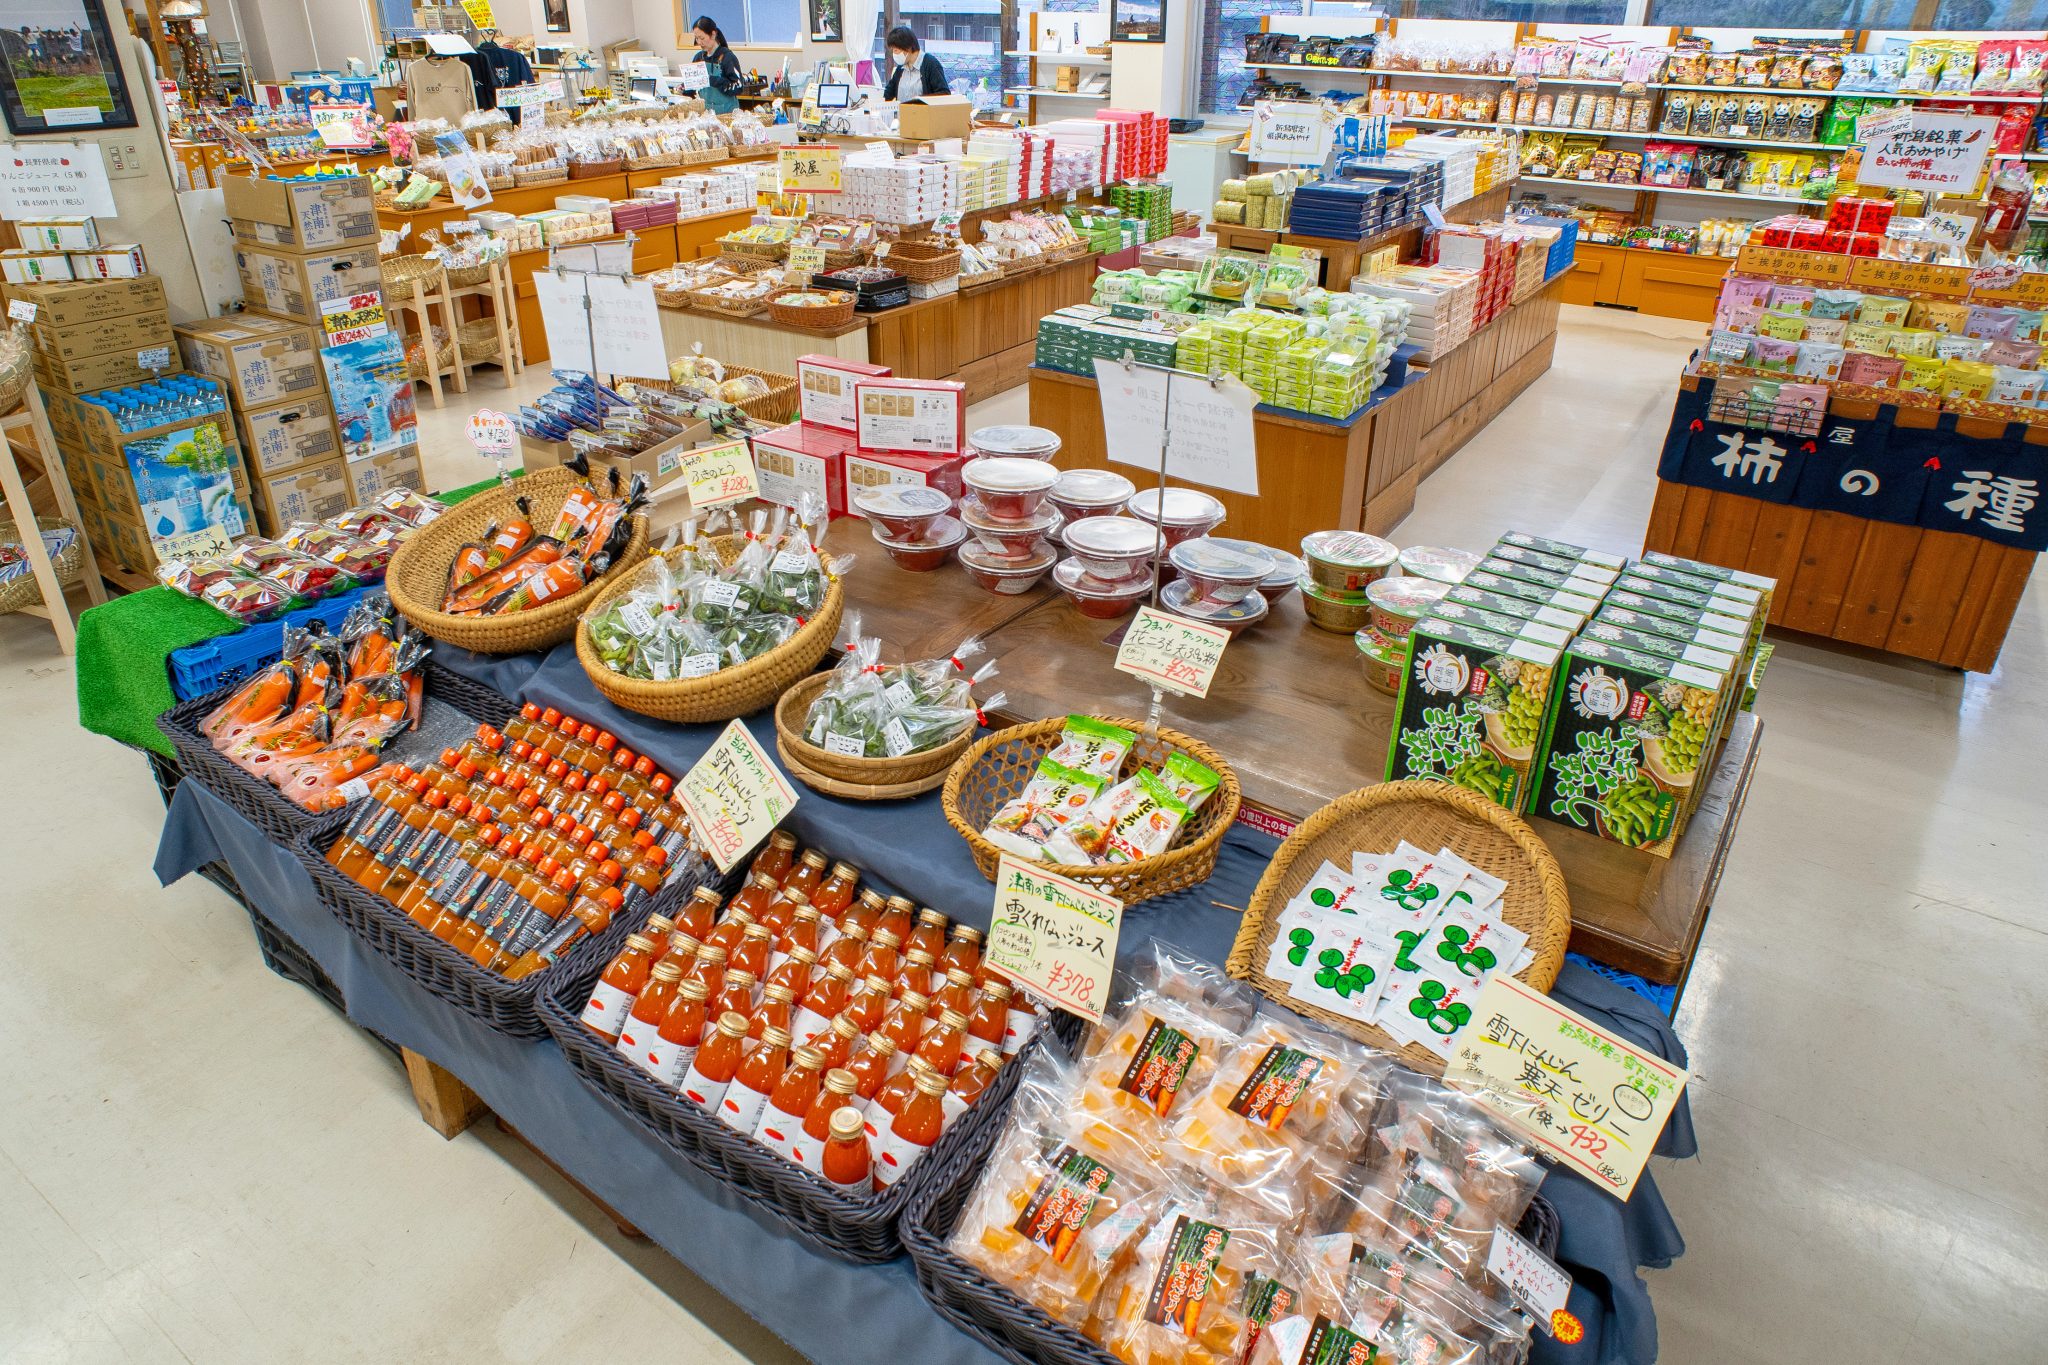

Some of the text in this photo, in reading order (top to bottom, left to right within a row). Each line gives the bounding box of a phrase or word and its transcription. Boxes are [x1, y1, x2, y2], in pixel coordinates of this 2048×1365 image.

[1859, 121, 1910, 140] Kakinotane
[1878, 143, 1969, 159] 人気おみやげ
[25, 158, 60, 166] 長野県産
[793, 160, 821, 176] 松屋
[1747, 256, 1839, 274] ご挨拶の柿の種
[1862, 268, 1961, 288] ご挨拶の柿の種
[691, 460, 736, 483] ふきのとう
[721, 475, 749, 495] ¥280
[1046, 960, 1095, 1002] ¥378
[1486, 1012, 1582, 1085] 雪下にんじん
[1570, 1124, 1609, 1159] 432
[1512, 1279, 1530, 1301] 540
